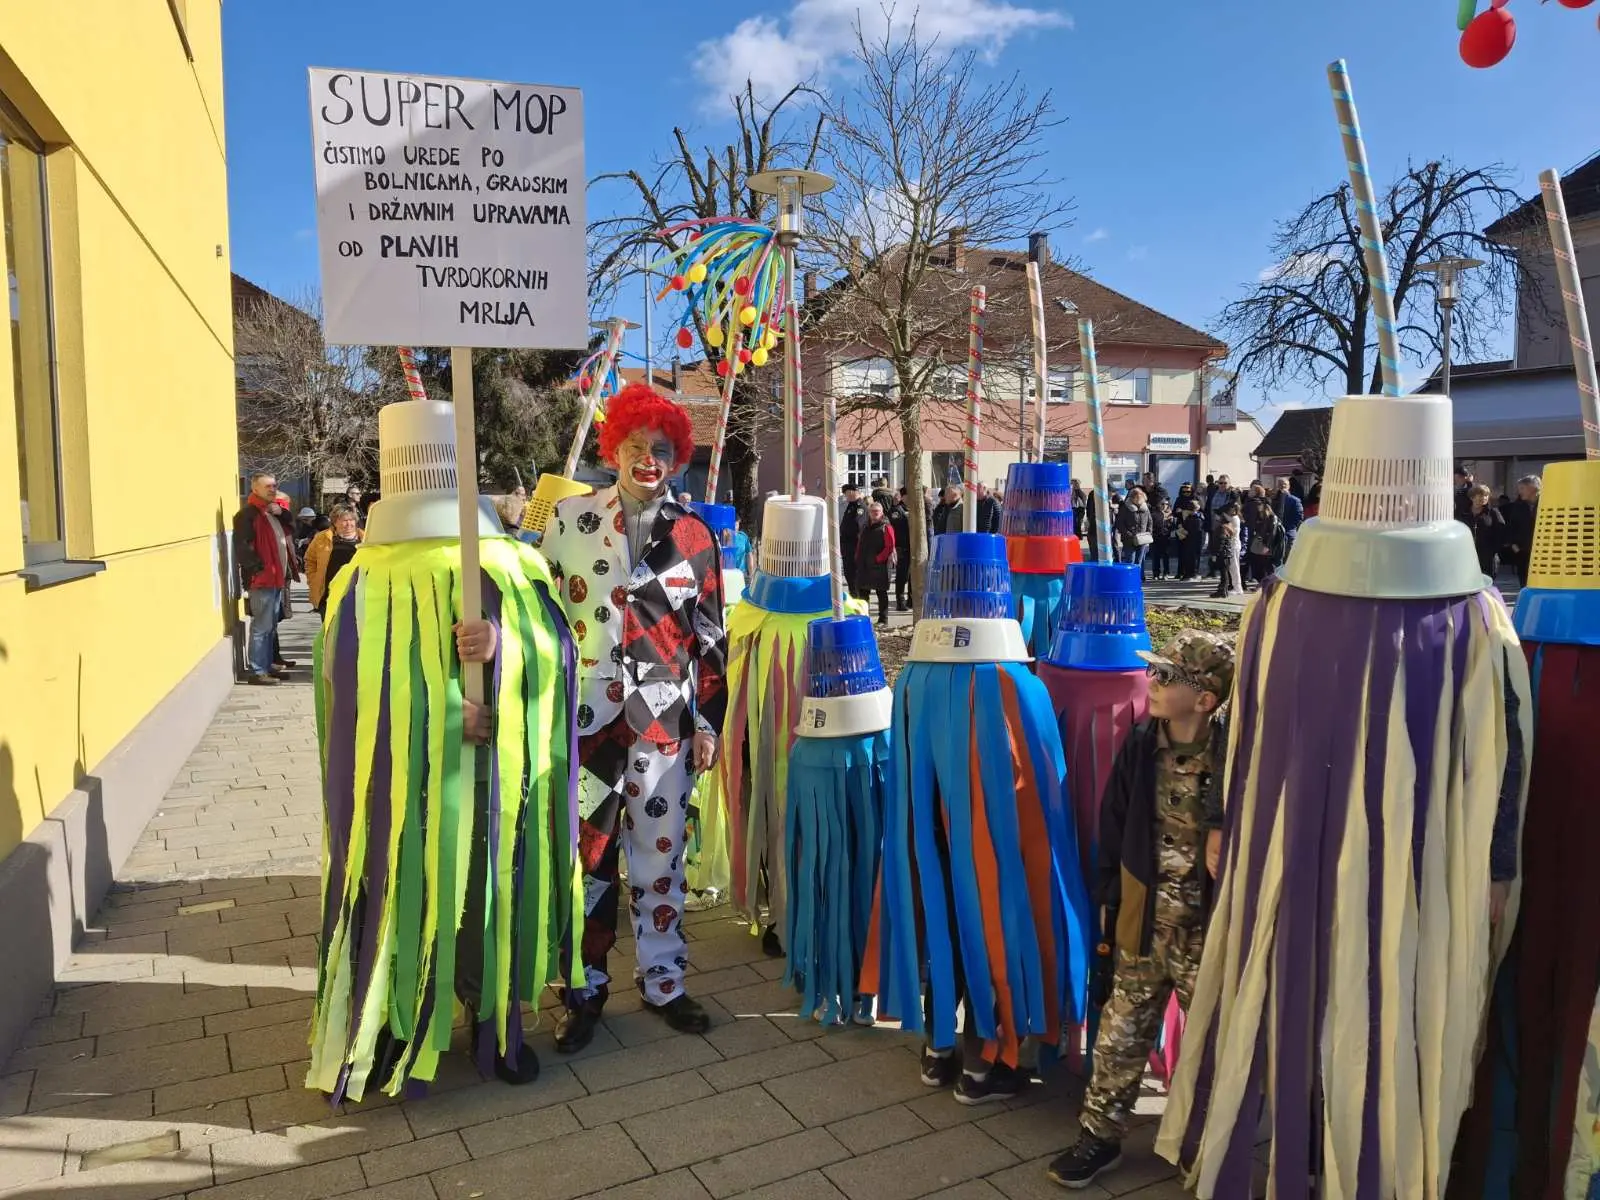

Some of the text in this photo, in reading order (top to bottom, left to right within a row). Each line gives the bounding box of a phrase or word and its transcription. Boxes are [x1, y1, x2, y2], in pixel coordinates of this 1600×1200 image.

[321, 74, 567, 135] SUPER MOP
[323, 140, 504, 167] ČISTIMO UREDE PO
[365, 171, 568, 195] BOLNICAMA, GRADSKIM
[349, 196, 571, 225] I DRŽAVNIM UPRAVAMA
[338, 234, 459, 258] OD PLAVIH
[415, 264, 548, 290] TVRDOKORNIH
[459, 300, 535, 327] MRLJA
